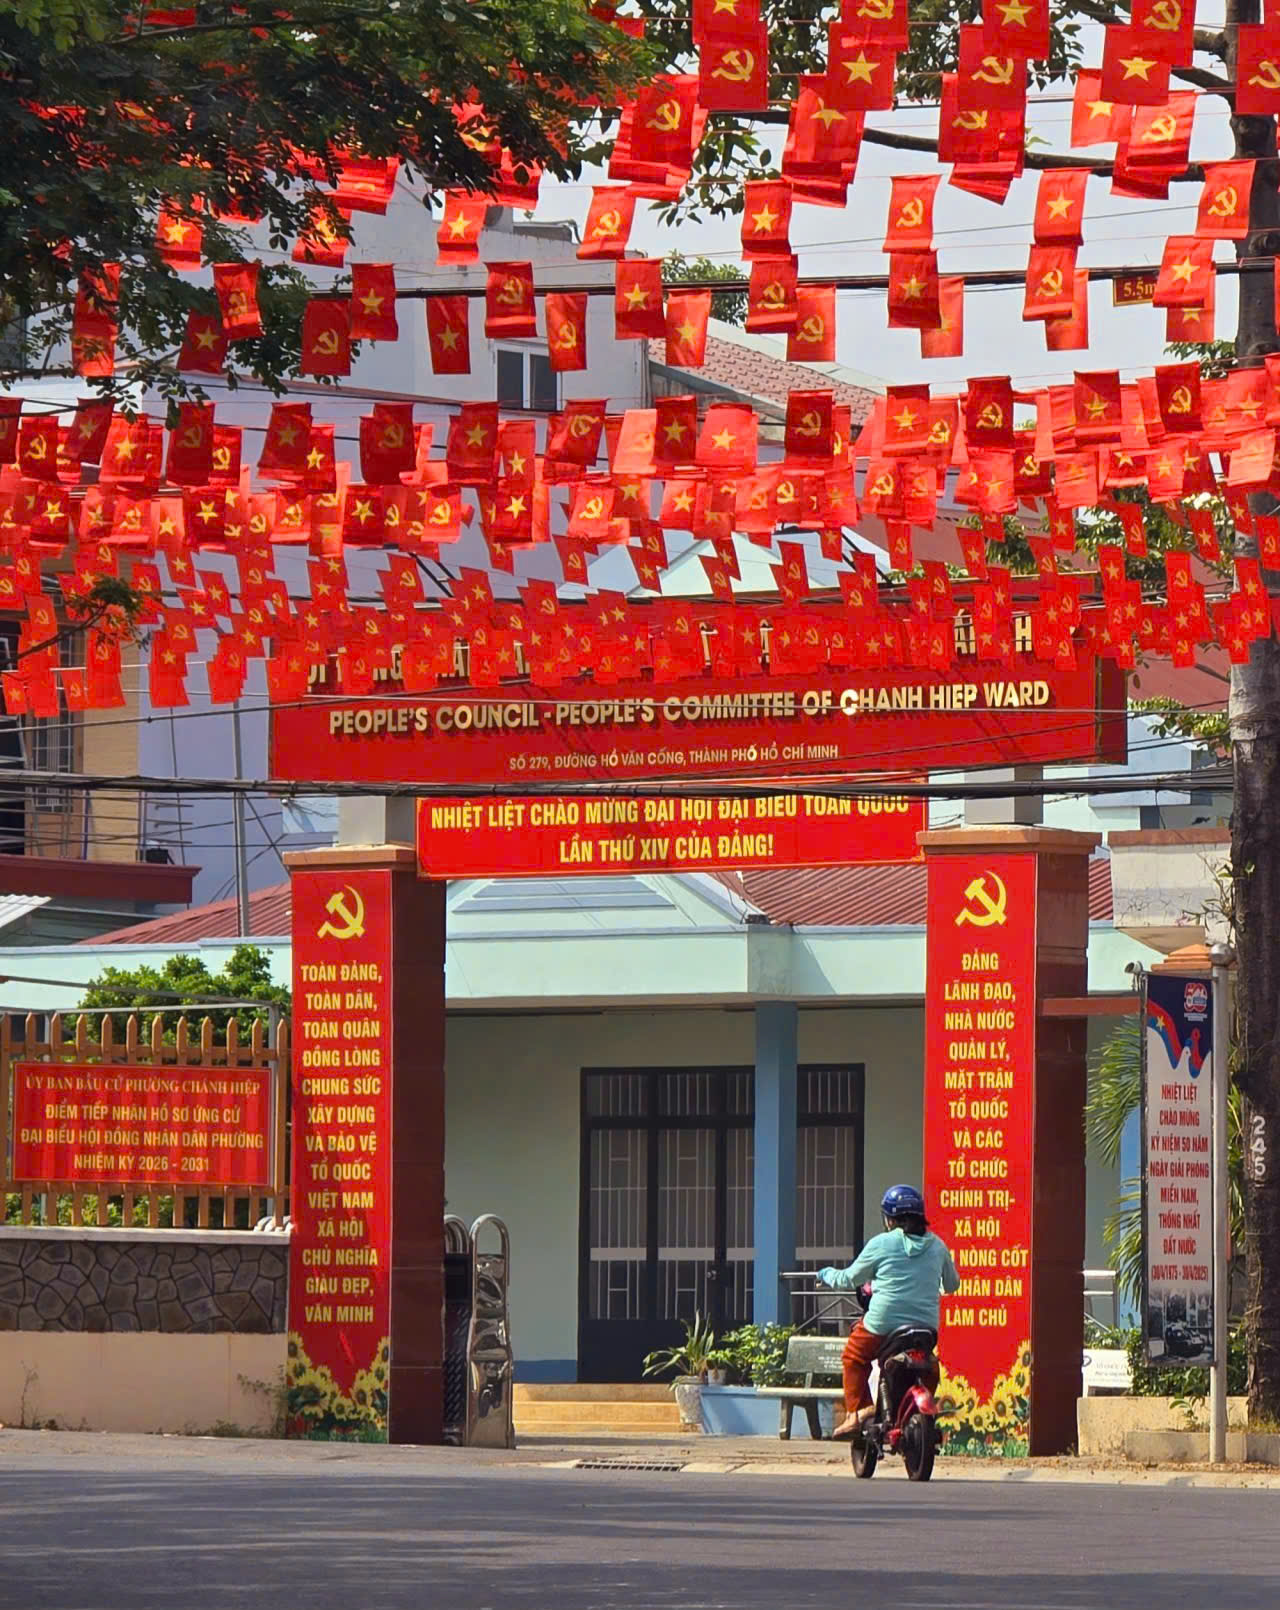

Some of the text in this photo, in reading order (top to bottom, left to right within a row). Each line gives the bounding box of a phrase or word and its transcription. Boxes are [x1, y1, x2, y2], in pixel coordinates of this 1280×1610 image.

[436, 704, 539, 731] COUNCIL
[663, 692, 796, 722] COMMITTEE
[802, 690, 832, 716] OF
[840, 686, 923, 716] CHANH
[930, 683, 977, 711] HIEP
[983, 680, 1050, 708] WARD
[529, 755, 551, 771] 279,
[554, 752, 597, 768] ĐƯỜNG
[689, 746, 728, 763] THÀNH
[732, 744, 757, 761] PHỐ
[782, 743, 805, 759] CHÍ
[807, 745, 839, 759] MINH
[431, 798, 748, 832] NHIỆT LIỆT CHÀO MỪNG ĐẠI ĐẠI
[559, 832, 773, 864] LẦN THỨ XIV CỦA ĐẢNG!
[962, 948, 999, 971] ĐẢNG
[301, 960, 382, 983] TOÀN ĐẢNG,
[305, 989, 378, 1011] TOÀN DÂN,
[945, 980, 1016, 1004] LÃNH ĐẠO,
[303, 1018, 380, 1039] TOÀN QUÂN
[945, 1008, 1015, 1030] NHÀ NƯỚC
[344, 1046, 380, 1067] LÒNG
[949, 1037, 1010, 1062] QUẢN LÝ,
[47, 1076, 73, 1090] BAN
[302, 1074, 381, 1096] CHUNG SỨC
[945, 1068, 1013, 1093] MẶT TRẬN
[1162, 1082, 1197, 1104] NHIỆT LIỆT
[193, 1104, 219, 1123] ỨNG
[308, 1104, 375, 1127] XÂY DỰNG
[970, 1095, 1008, 1120] QUỐC
[21, 1128, 42, 1146] ĐẠI
[306, 1131, 377, 1155] VÀ BẢO VỆ
[953, 1127, 1003, 1148] VÀ CÁC
[1182, 1137, 1190, 1152] 50
[138, 1157, 168, 1170] 2026
[181, 1157, 208, 1171] 2031
[333, 1157, 371, 1180] QUỐC
[948, 1153, 1008, 1178] TỔ CHỨC
[308, 1188, 374, 1212] VIỆT NAM
[940, 1186, 983, 1208] CHÍNH
[1180, 1188, 1199, 1206] NAM,
[317, 1216, 364, 1241] XÃ HỘI
[955, 1216, 1000, 1240] XÃ HỘI
[302, 1245, 378, 1266] CHỦ NGHĨA
[960, 1245, 997, 1267] NÒNG
[1001, 1244, 1028, 1267] CỐT
[306, 1274, 375, 1298] GIÀU ĐẸP,
[995, 1275, 1022, 1296] DÂN
[305, 1303, 374, 1323] VĂN MINH
[945, 1305, 1007, 1326] LÀM CHỦ
